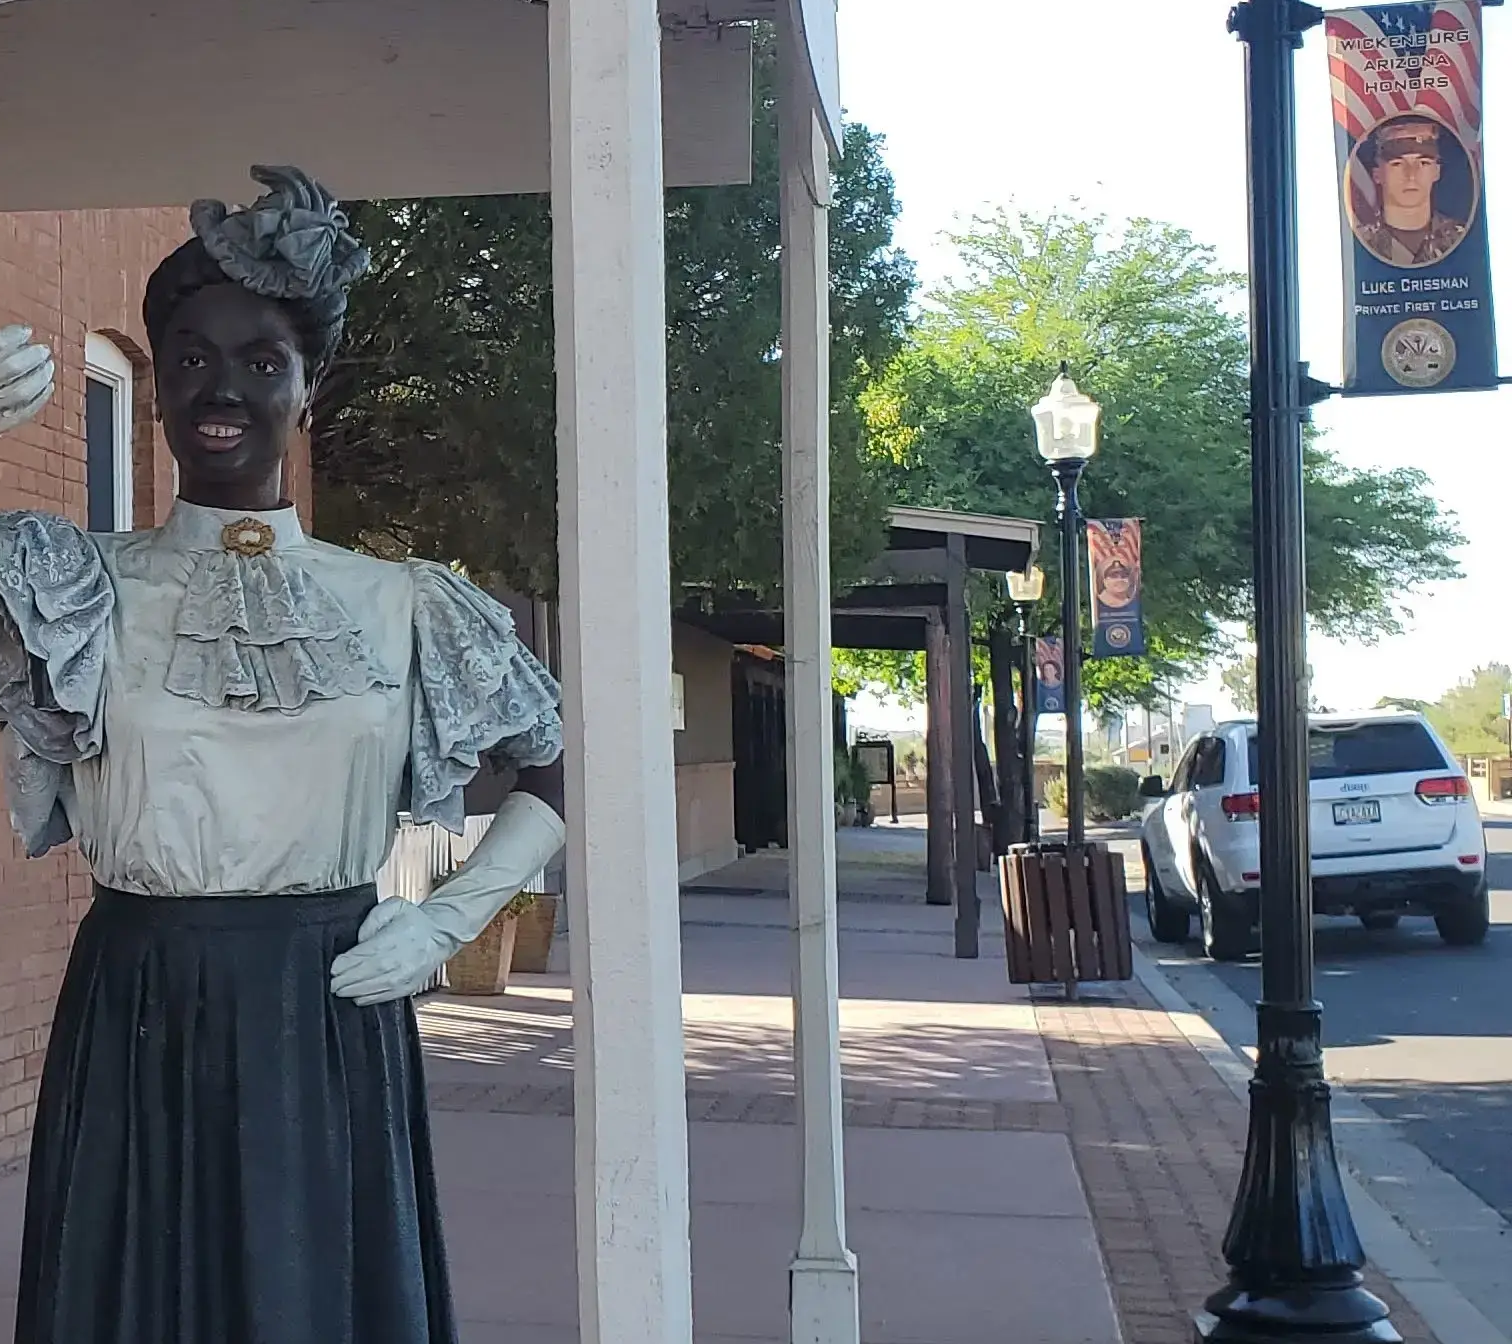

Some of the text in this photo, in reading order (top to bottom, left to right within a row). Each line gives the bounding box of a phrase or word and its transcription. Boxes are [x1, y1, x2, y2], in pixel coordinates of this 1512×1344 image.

[1340, 30, 1469, 51] WICKENBURG
[1363, 54, 1449, 72] ARIZONA
[1365, 76, 1449, 94] HONORS
[1361, 277, 1469, 295] LUKE CRISSMAN
[1354, 299, 1479, 316] PRIVATE FIRST CLASS
